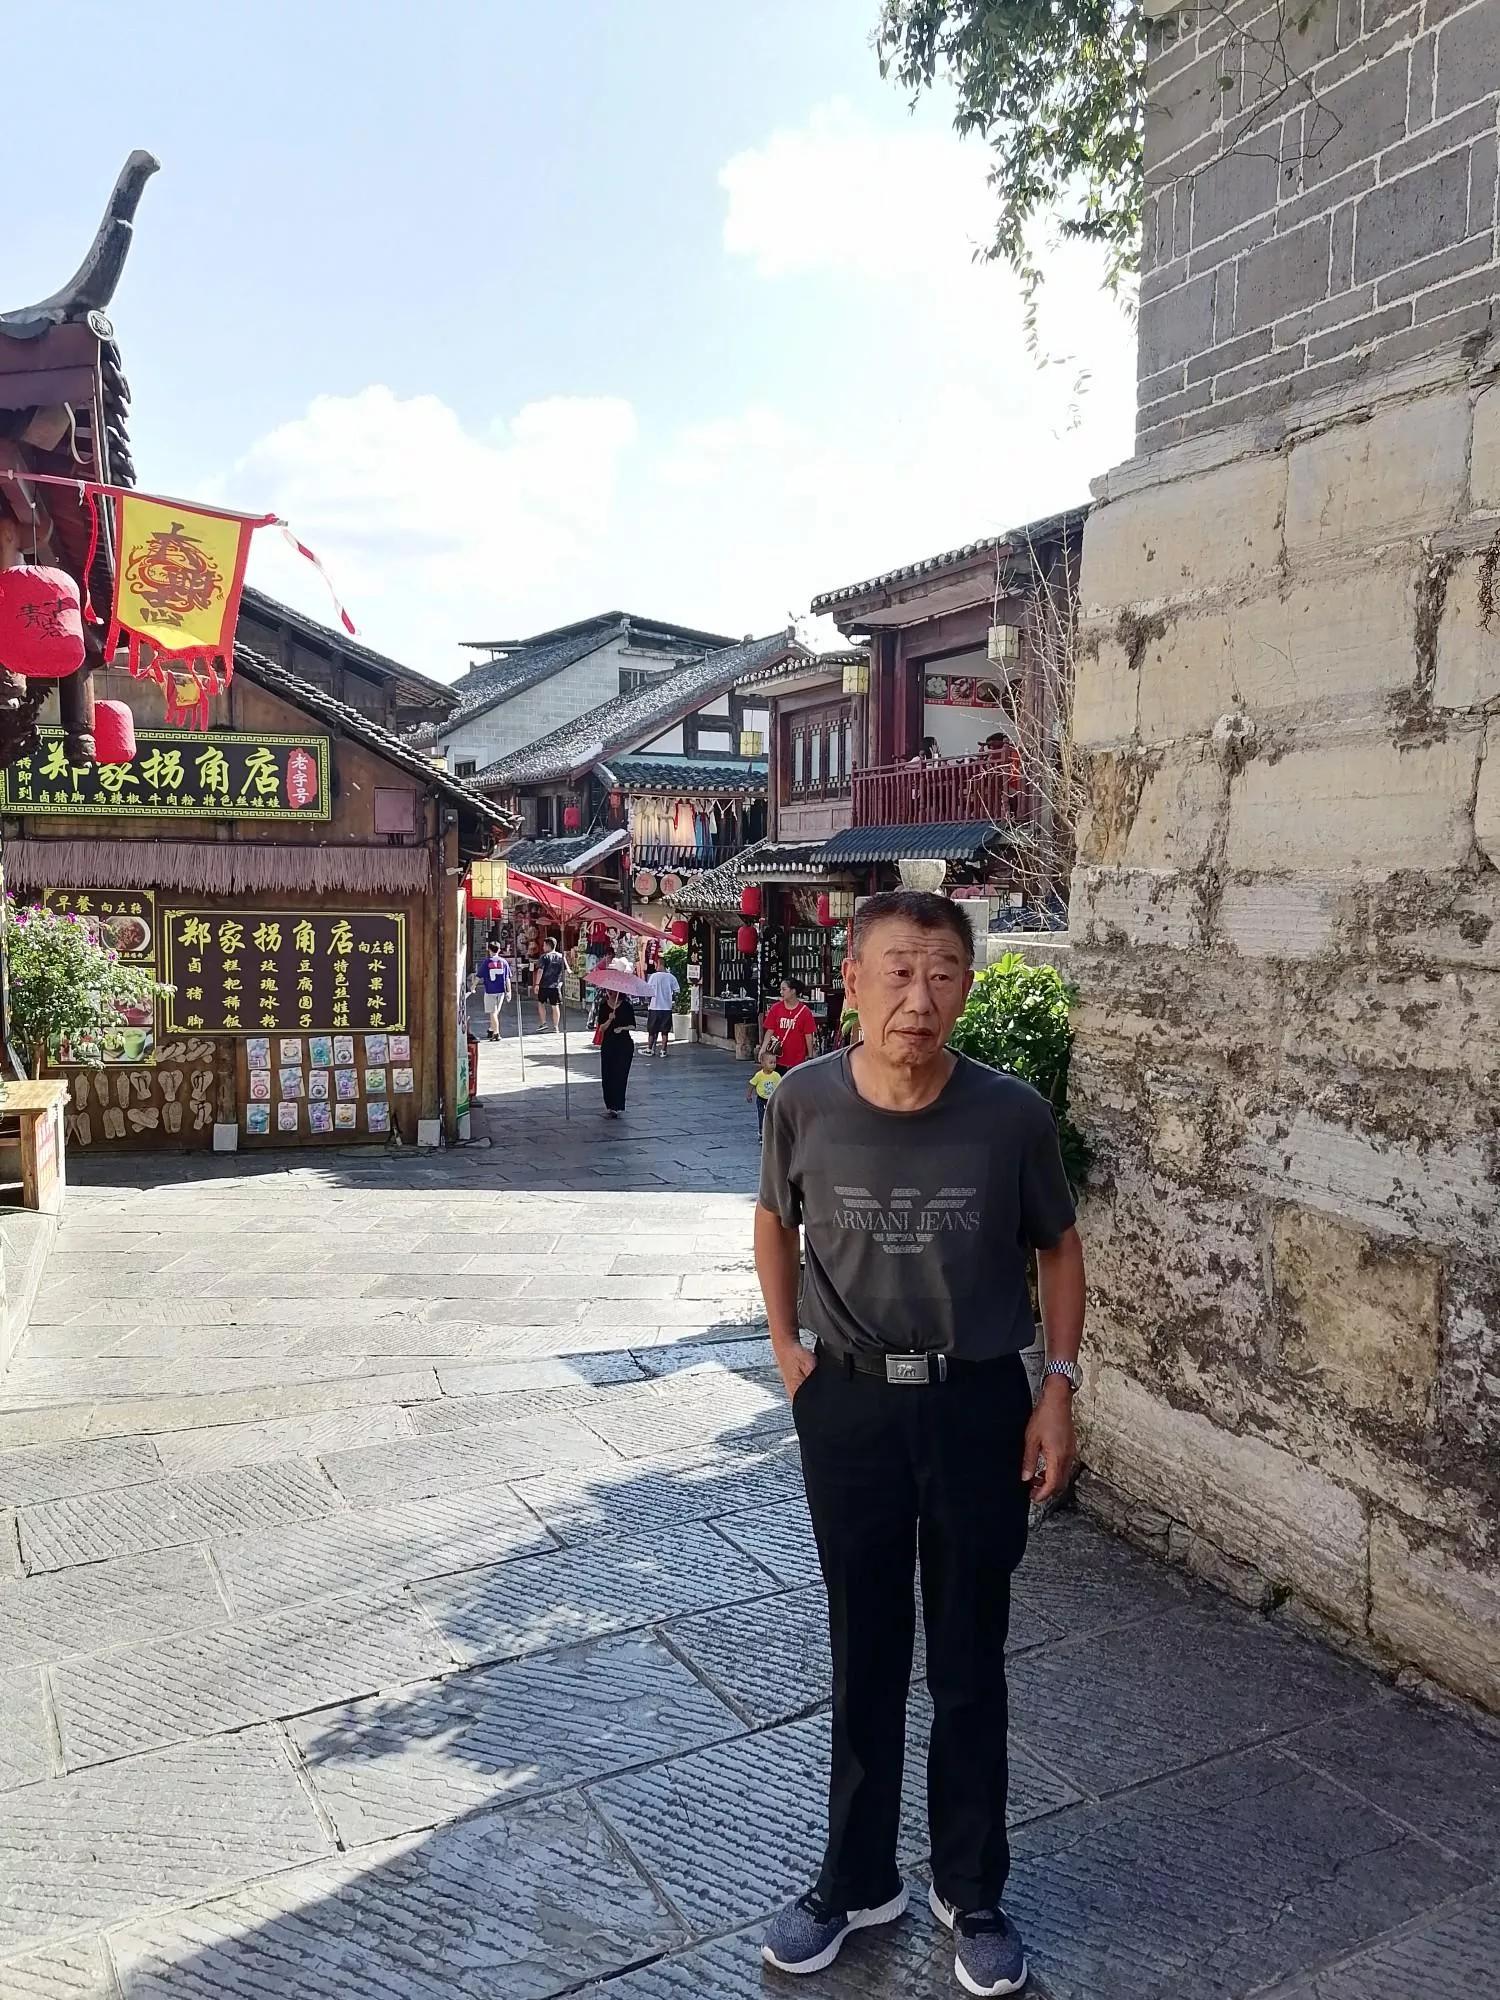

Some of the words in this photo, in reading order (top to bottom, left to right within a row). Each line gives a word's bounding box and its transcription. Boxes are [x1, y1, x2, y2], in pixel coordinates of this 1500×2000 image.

[39, 790, 85, 803] 卤猪脚
[148, 793, 196, 806] 牛肉粉
[202, 795, 281, 808] 特色丝娃娃
[291, 753, 309, 803] 老字号
[56, 895, 94, 912] 早餐
[101, 902, 143, 914] 向左转
[178, 917, 354, 955] 郑家拐角店
[358, 940, 396, 954] 向左转
[186, 957, 204, 1029] 卤猪脚
[259, 958, 280, 1029] 玫瑰冰粉
[296, 959, 314, 1028] 豆腐圆子
[332, 958, 351, 1028] 特色丝娃娃
[366, 958, 387, 1027] 水果冰浆
[832, 1209, 909, 1230] ARMANI
[916, 1210, 980, 1230] JEANS
